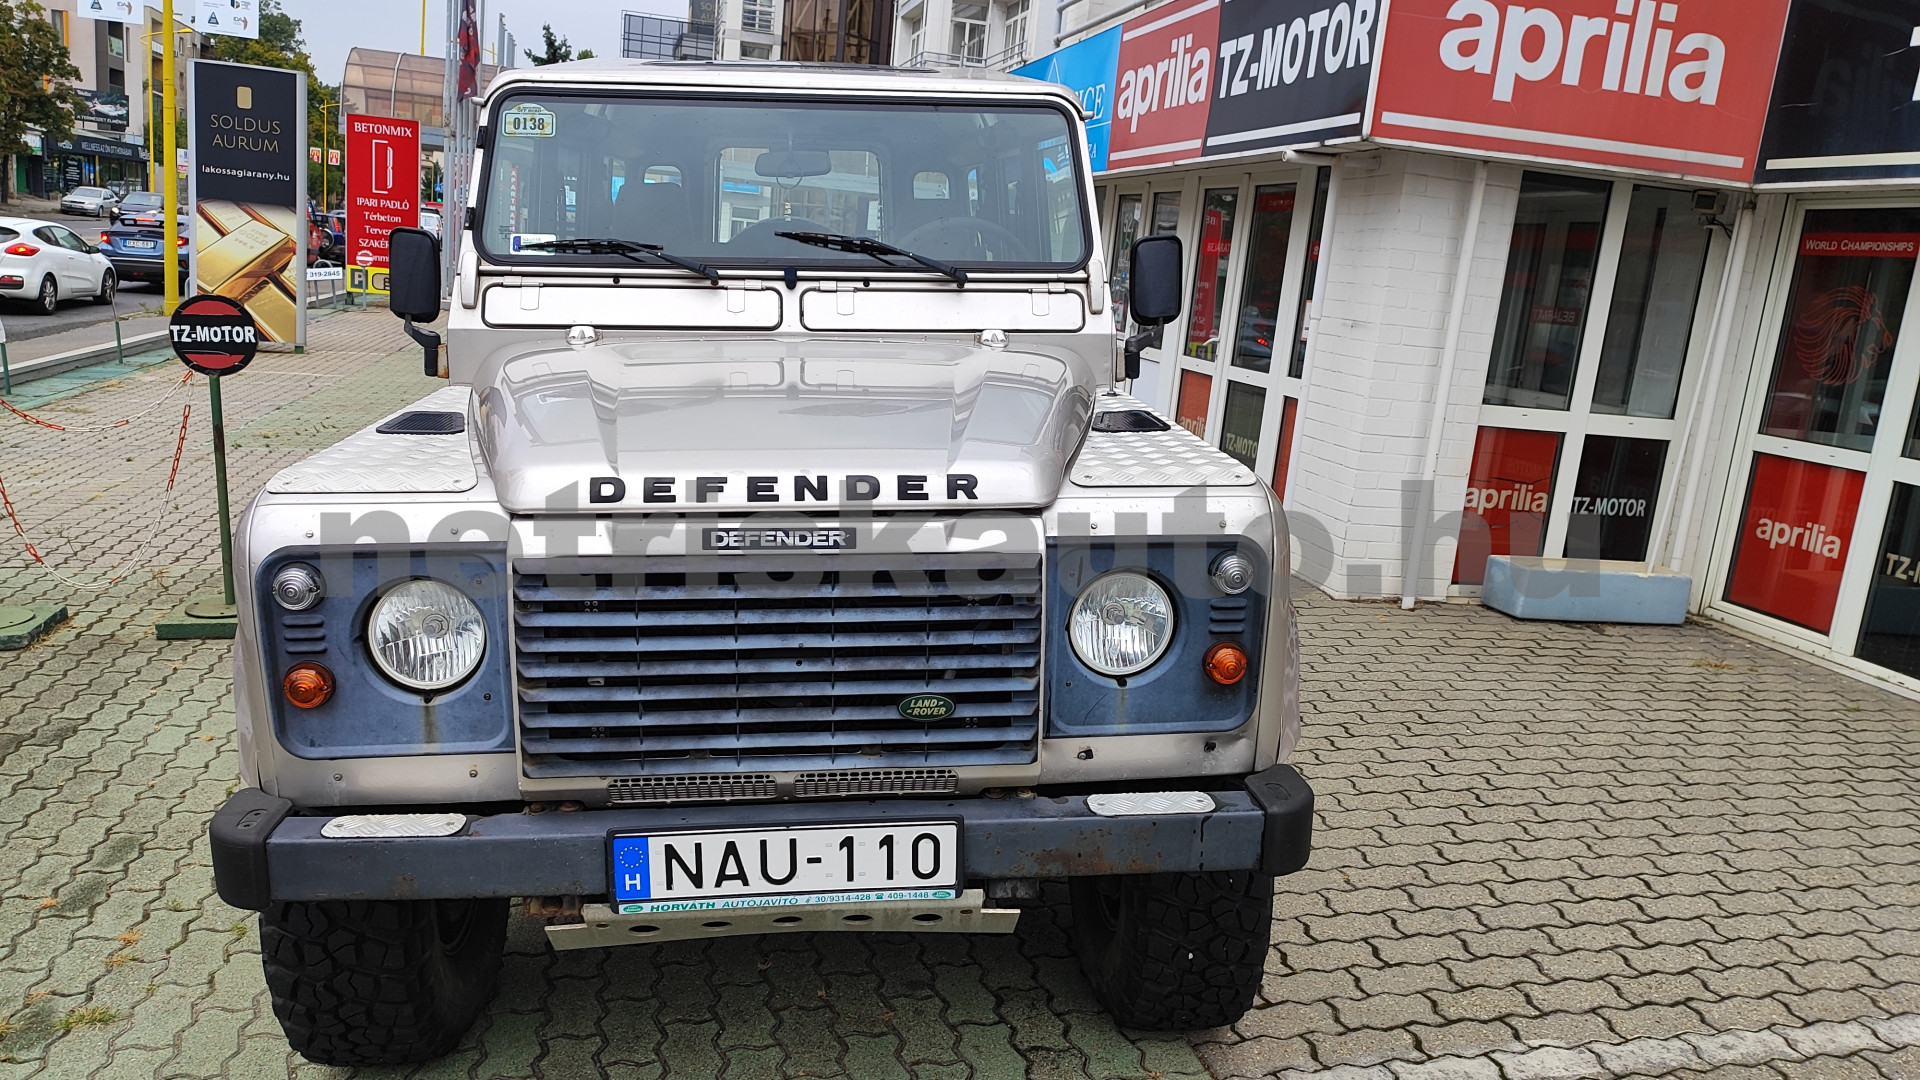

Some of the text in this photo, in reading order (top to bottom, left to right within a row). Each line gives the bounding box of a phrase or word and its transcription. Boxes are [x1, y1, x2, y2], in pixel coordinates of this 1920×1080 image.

[1218, 0, 1378, 100] TZ-MOTOR
[1439, 0, 1726, 106] aprilia
[1117, 33, 1211, 133] aprilia
[210, 114, 281, 135] SOLDUS
[354, 122, 412, 138] BETONMIX
[513, 117, 545, 130] 0138
[212, 133, 279, 153] AURUM
[202, 165, 290, 181] lakossagiarany.hu
[356, 197, 410, 210] IPARI PADLÓ
[363, 211, 402, 223] Térbeton
[239, 229, 269, 246] GOLD
[309, 270, 341, 279] 319-2845
[169, 325, 256, 343] TZ-MOTOR
[589, 474, 979, 503] DEFENDER
[1464, 483, 1549, 515] aprilia
[1573, 496, 1647, 517] TZ-MOTOR
[710, 530, 847, 547] DEFENDER
[1755, 517, 1842, 560] aprilia
[910, 699, 938, 708] LAND
[912, 707, 947, 715] ROVER
[664, 832, 941, 891] NAU-110
[625, 873, 641, 892] H
[650, 901, 716, 912] HORVÁTH
[722, 895, 799, 909] AUTÓJAVÍTÓ
[815, 893, 871, 903] 30/9314-428
[887, 891, 929, 900] 409-1448
